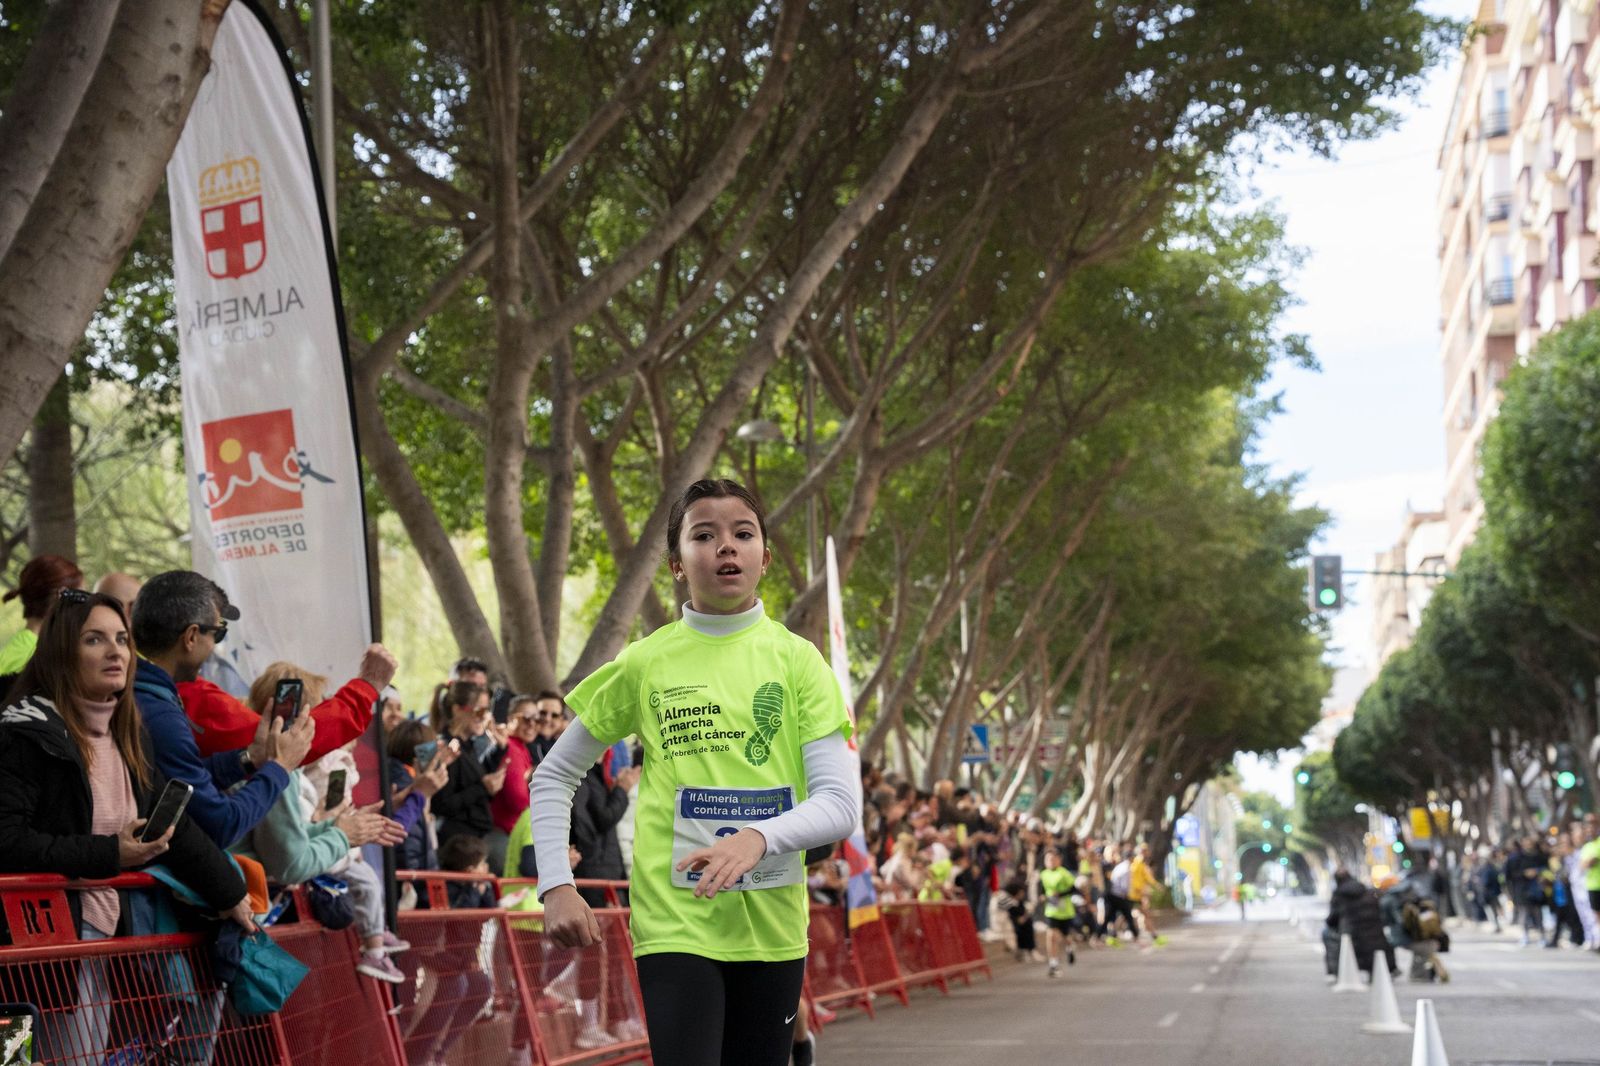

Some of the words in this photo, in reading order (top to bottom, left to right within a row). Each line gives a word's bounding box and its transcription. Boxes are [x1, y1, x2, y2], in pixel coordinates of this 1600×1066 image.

[664, 702, 721, 722] Almería
[669, 717, 713, 733] marcha
[691, 730, 702, 741] el
[705, 729, 746, 739] cáncer
[671, 749, 697, 758] febrero
[710, 745, 730, 753] 2026
[697, 793, 739, 804] Almería
[740, 796, 754, 805] en
[693, 806, 729, 816] contra
[731, 806, 742, 816] el
[744, 807, 776, 816] cáncer
